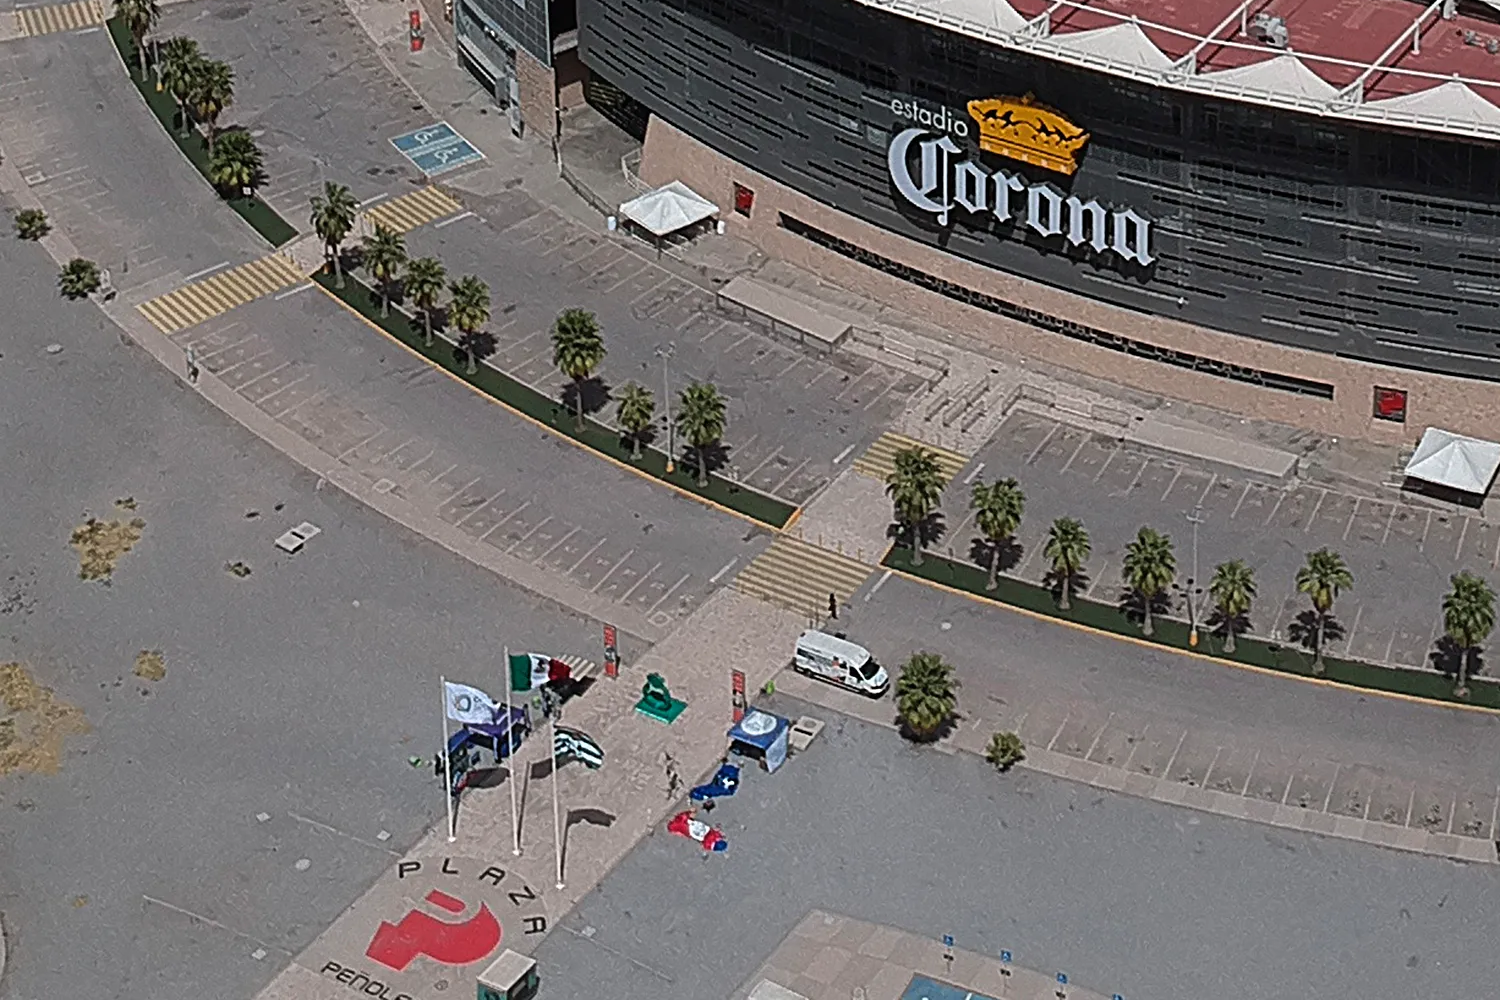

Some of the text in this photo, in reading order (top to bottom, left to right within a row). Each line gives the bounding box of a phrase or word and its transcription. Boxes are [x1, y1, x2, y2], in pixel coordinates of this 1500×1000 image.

[890, 98, 969, 138] estadio
[888, 128, 1156, 267] Corona
[398, 857, 548, 935] PLAZA
